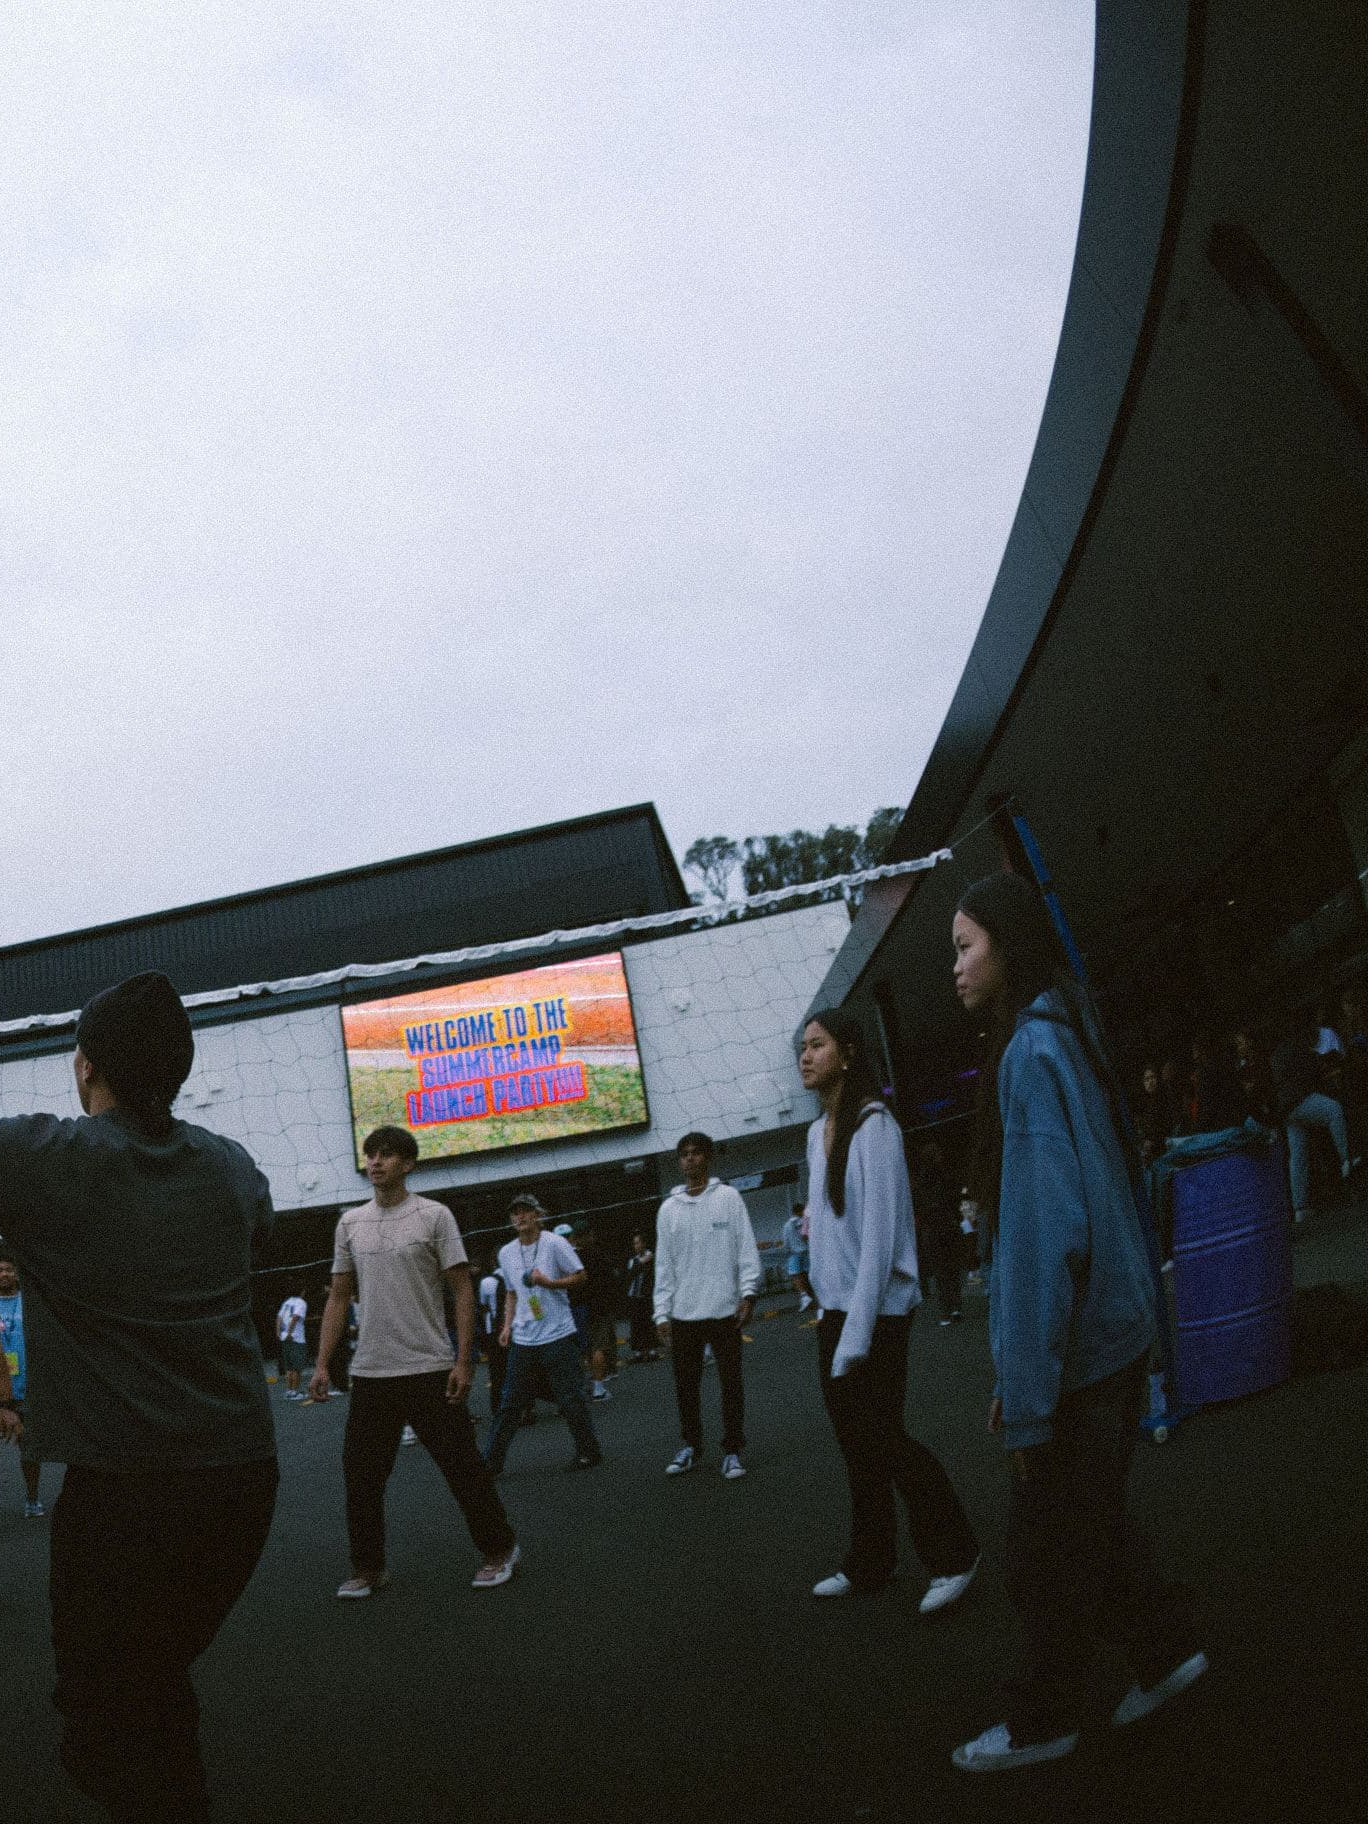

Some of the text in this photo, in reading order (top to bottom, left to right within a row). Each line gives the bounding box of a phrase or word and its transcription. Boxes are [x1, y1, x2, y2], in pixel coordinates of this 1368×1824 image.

[405, 998, 568, 1054] WELCOME TO THE
[421, 1034, 562, 1088] SUMMERCAMP
[408, 1082, 488, 1125] LAUNCH
